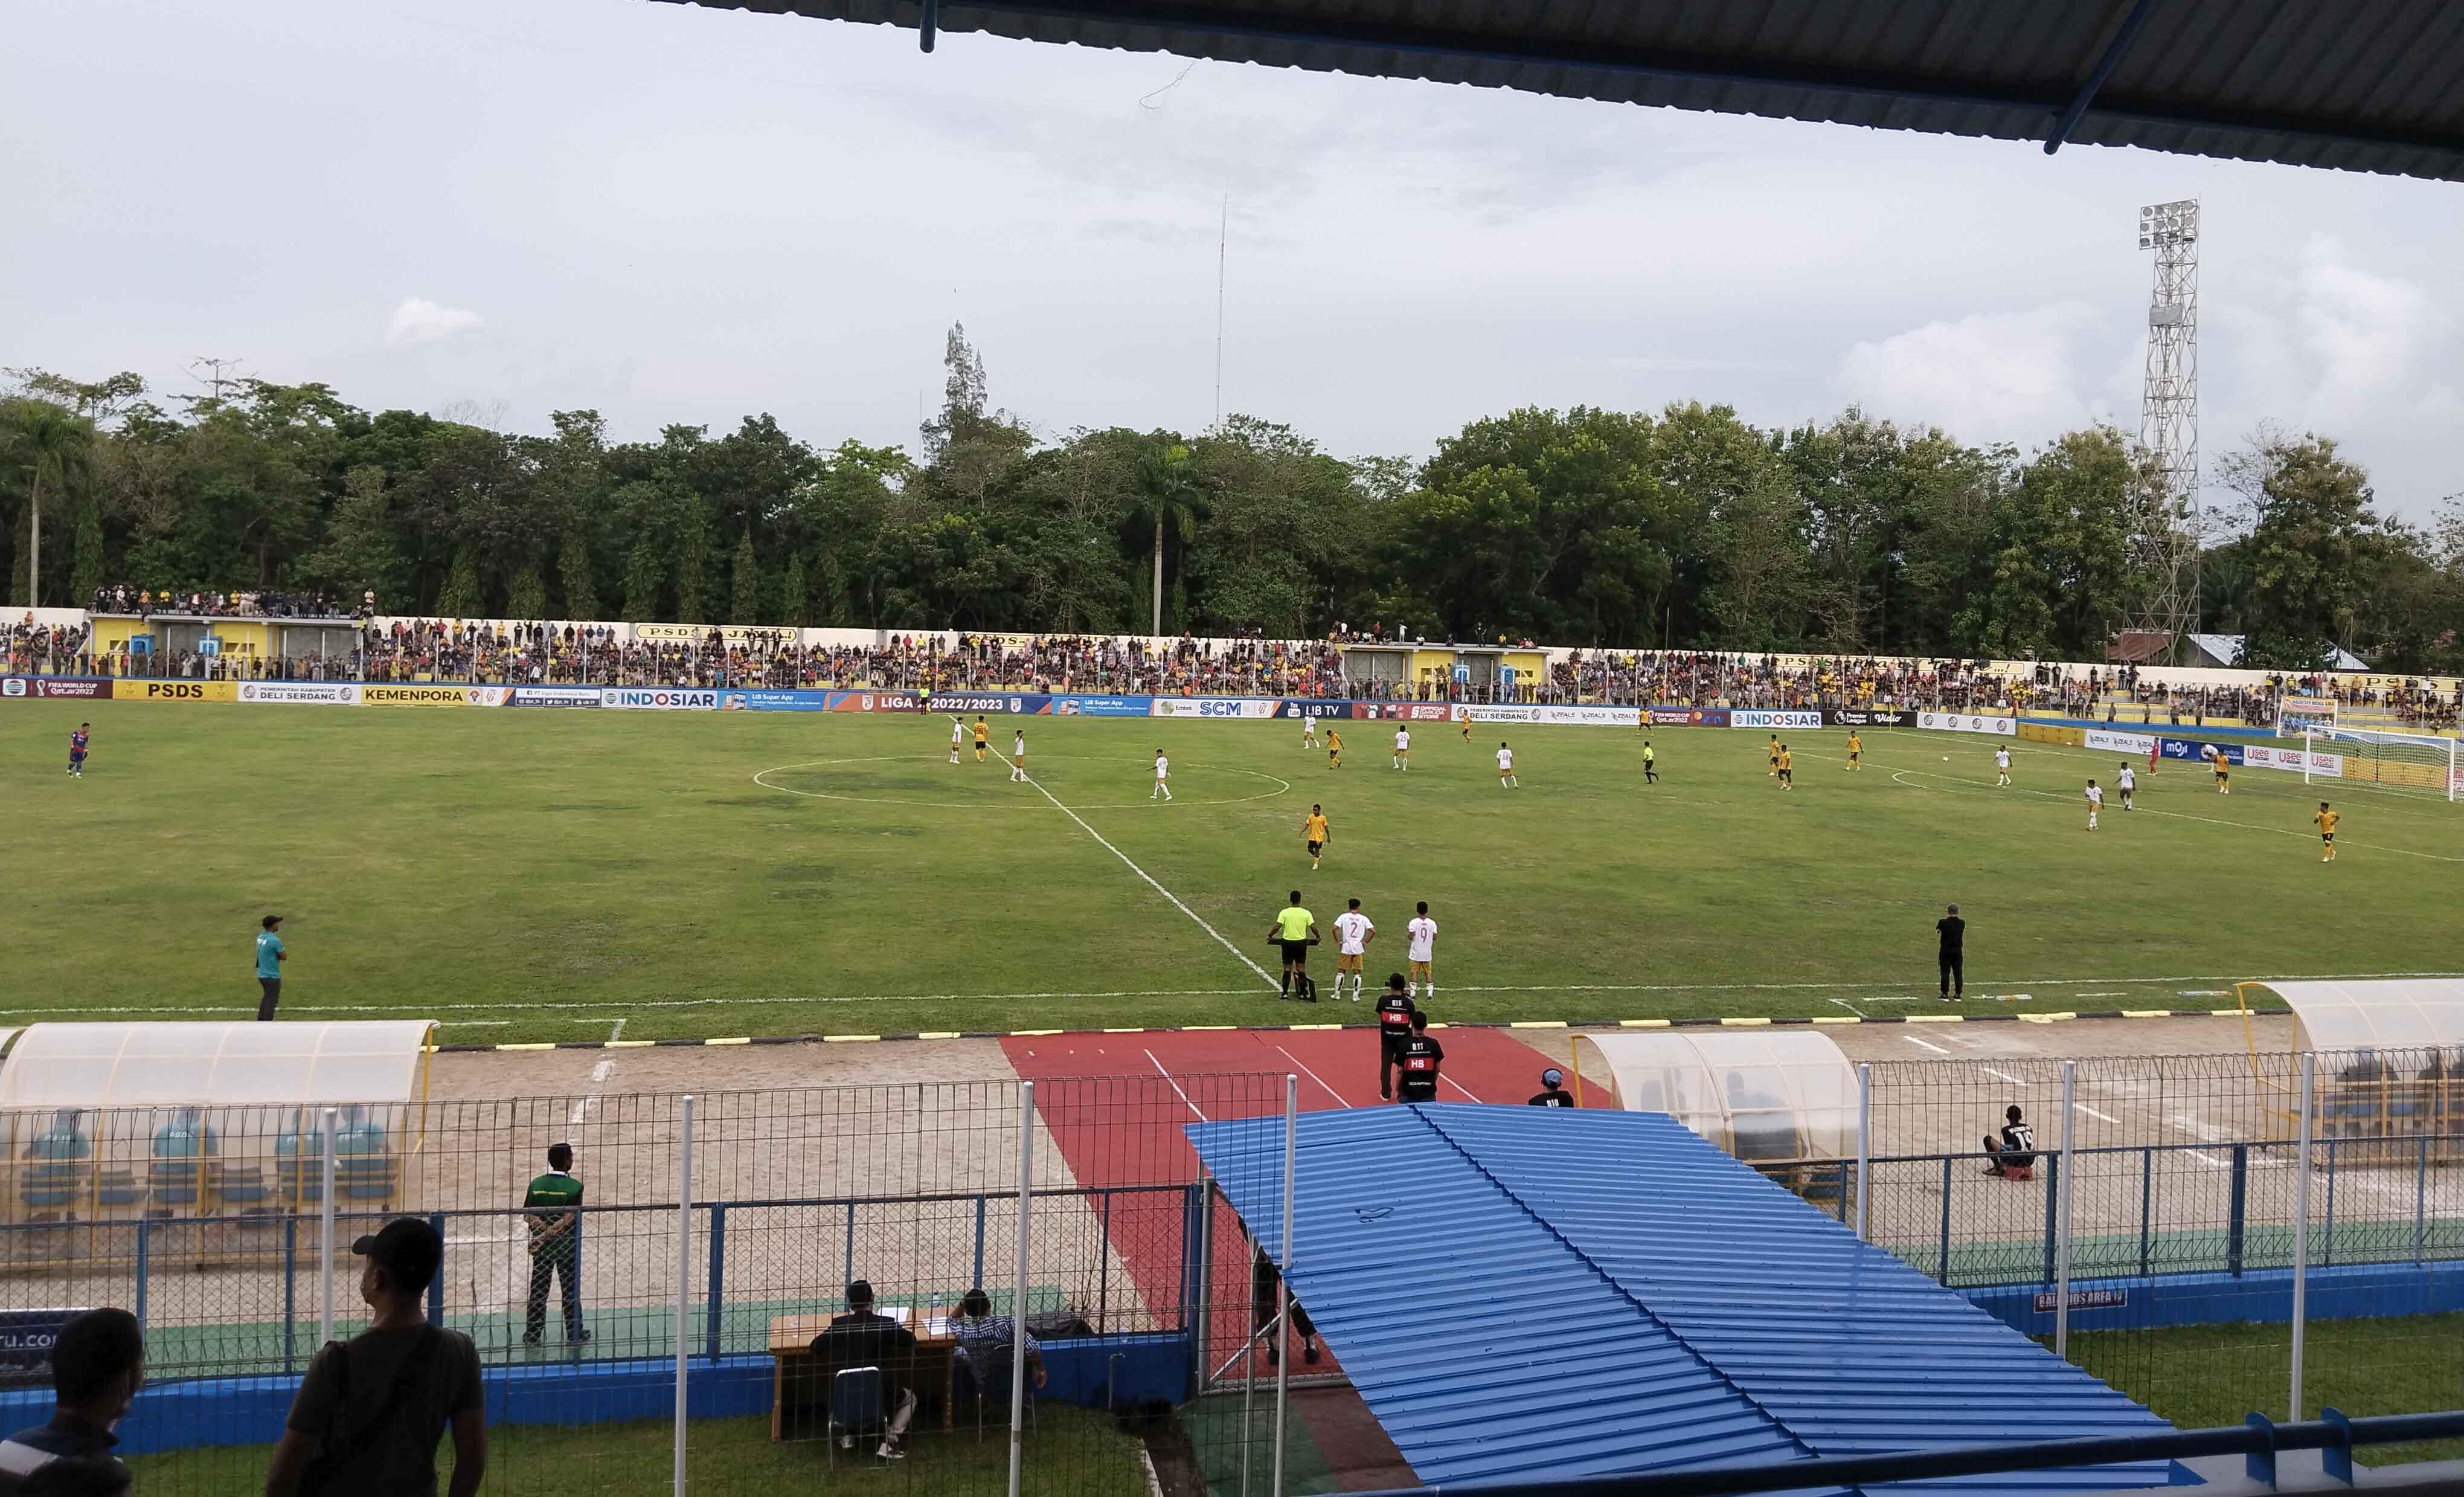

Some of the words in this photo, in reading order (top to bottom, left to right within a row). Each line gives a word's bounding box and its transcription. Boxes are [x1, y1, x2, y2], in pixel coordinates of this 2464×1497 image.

[148, 684, 203, 698] PSDS
[365, 689, 463, 701] KEMENPORA
[621, 692, 714, 706] INDOSIAR
[881, 697, 913, 708] LIGA
[1199, 701, 1241, 715] SCM
[1325, 706, 1339, 715] TV
[1746, 714, 1820, 726] INDOSIAR
[1875, 713, 1902, 723] Vidio
[2248, 748, 2269, 759] Usee
[2279, 752, 2301, 762] Usee
[2312, 755, 2334, 766] Usee
[1350, 922, 1358, 938] 2
[1420, 927, 1427, 943] 9
[1411, 1059, 1425, 1068] HB
[2015, 1132, 2034, 1151] 19
